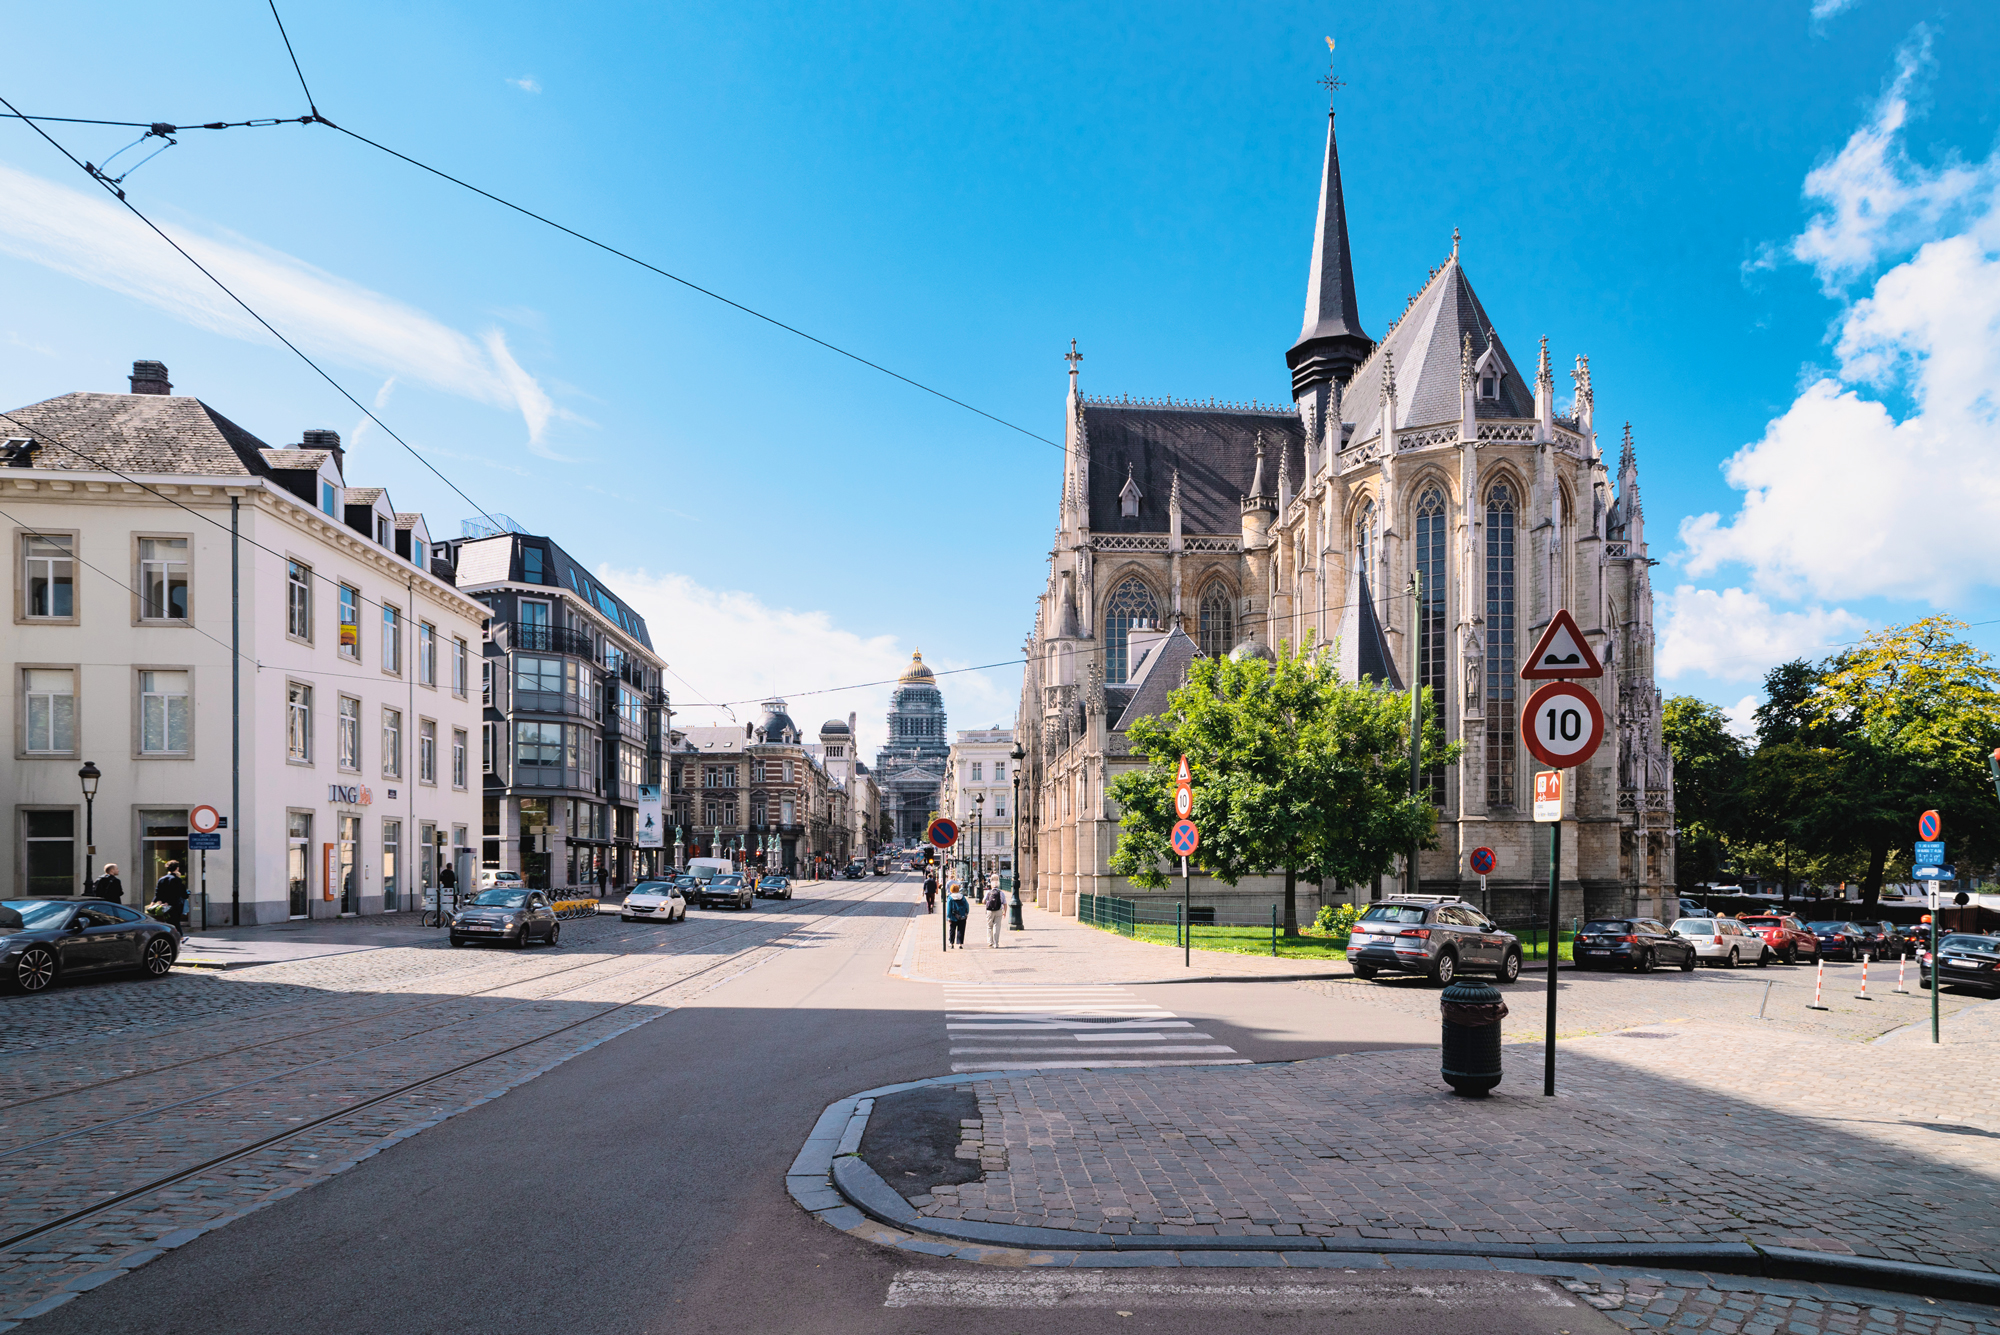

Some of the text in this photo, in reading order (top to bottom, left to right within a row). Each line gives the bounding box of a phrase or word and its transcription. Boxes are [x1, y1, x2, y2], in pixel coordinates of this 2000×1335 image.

[1547, 709, 1581, 741] 10
[332, 785, 357, 804] ING
[1180, 794, 1188, 808] 10
